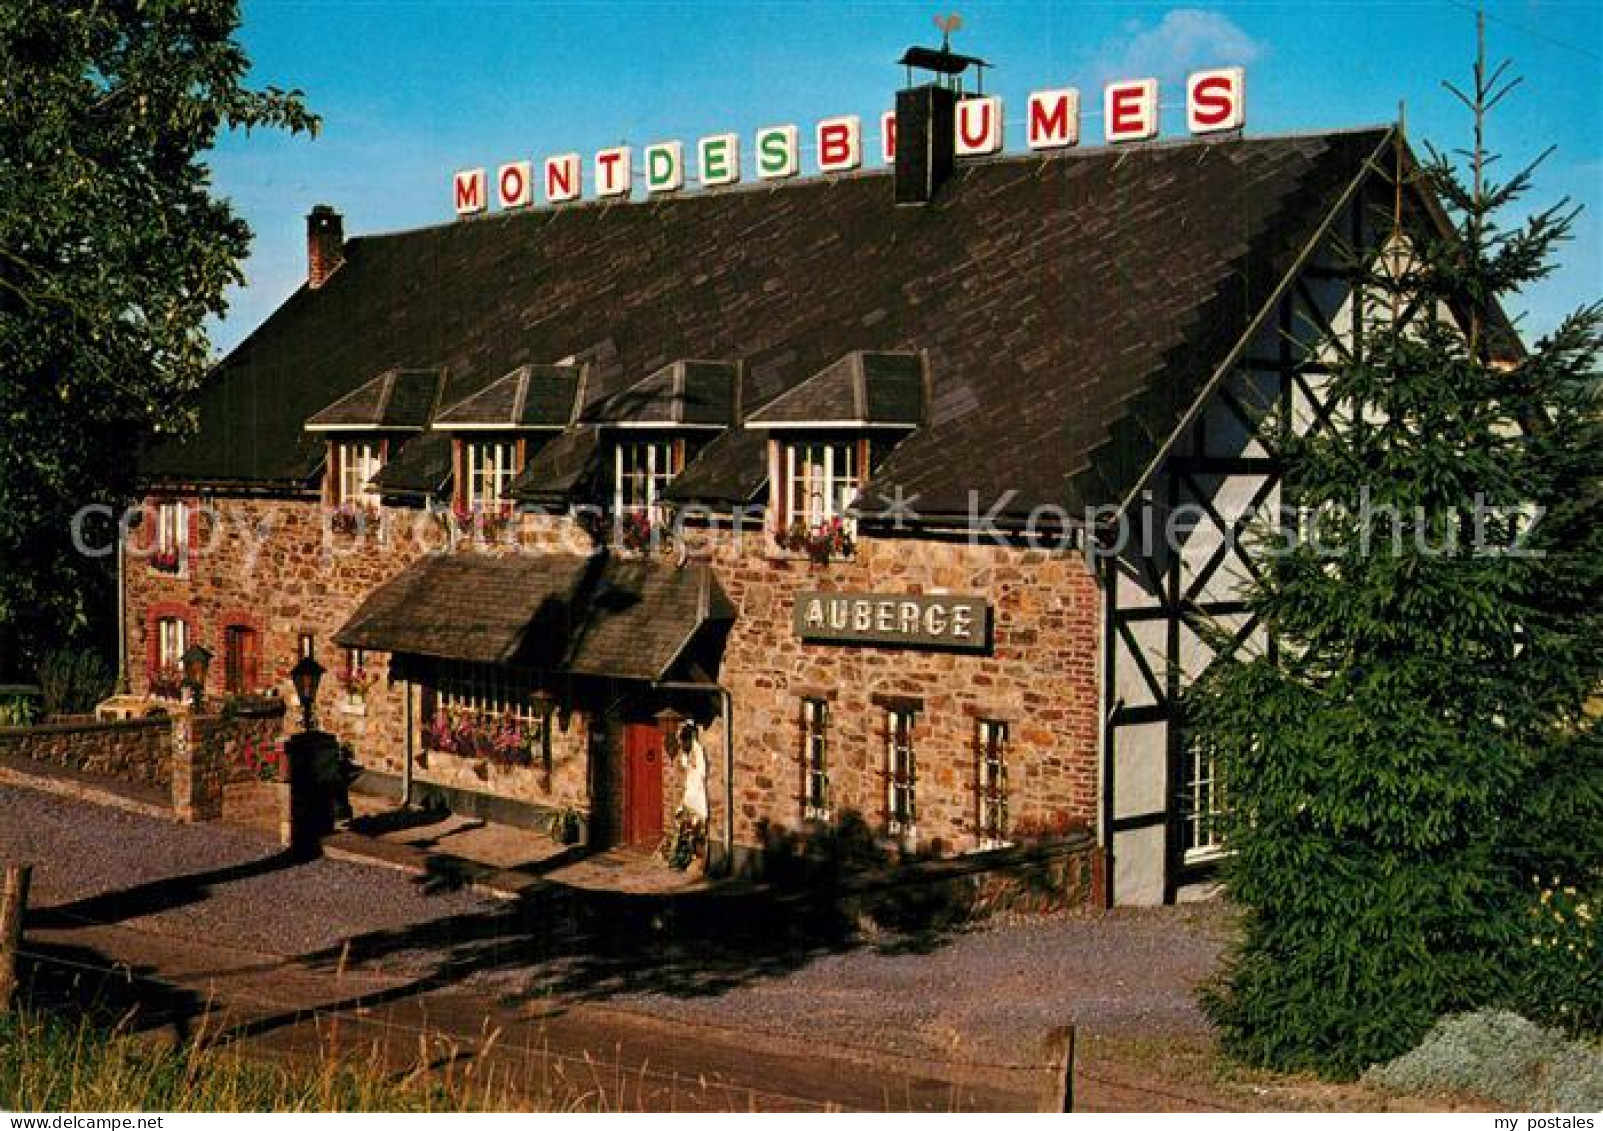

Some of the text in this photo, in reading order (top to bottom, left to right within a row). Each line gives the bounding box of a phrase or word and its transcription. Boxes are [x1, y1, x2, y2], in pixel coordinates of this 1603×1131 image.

[456, 77, 1233, 208] MONT DES BUMES
[805, 599, 972, 638] AUBERGE
